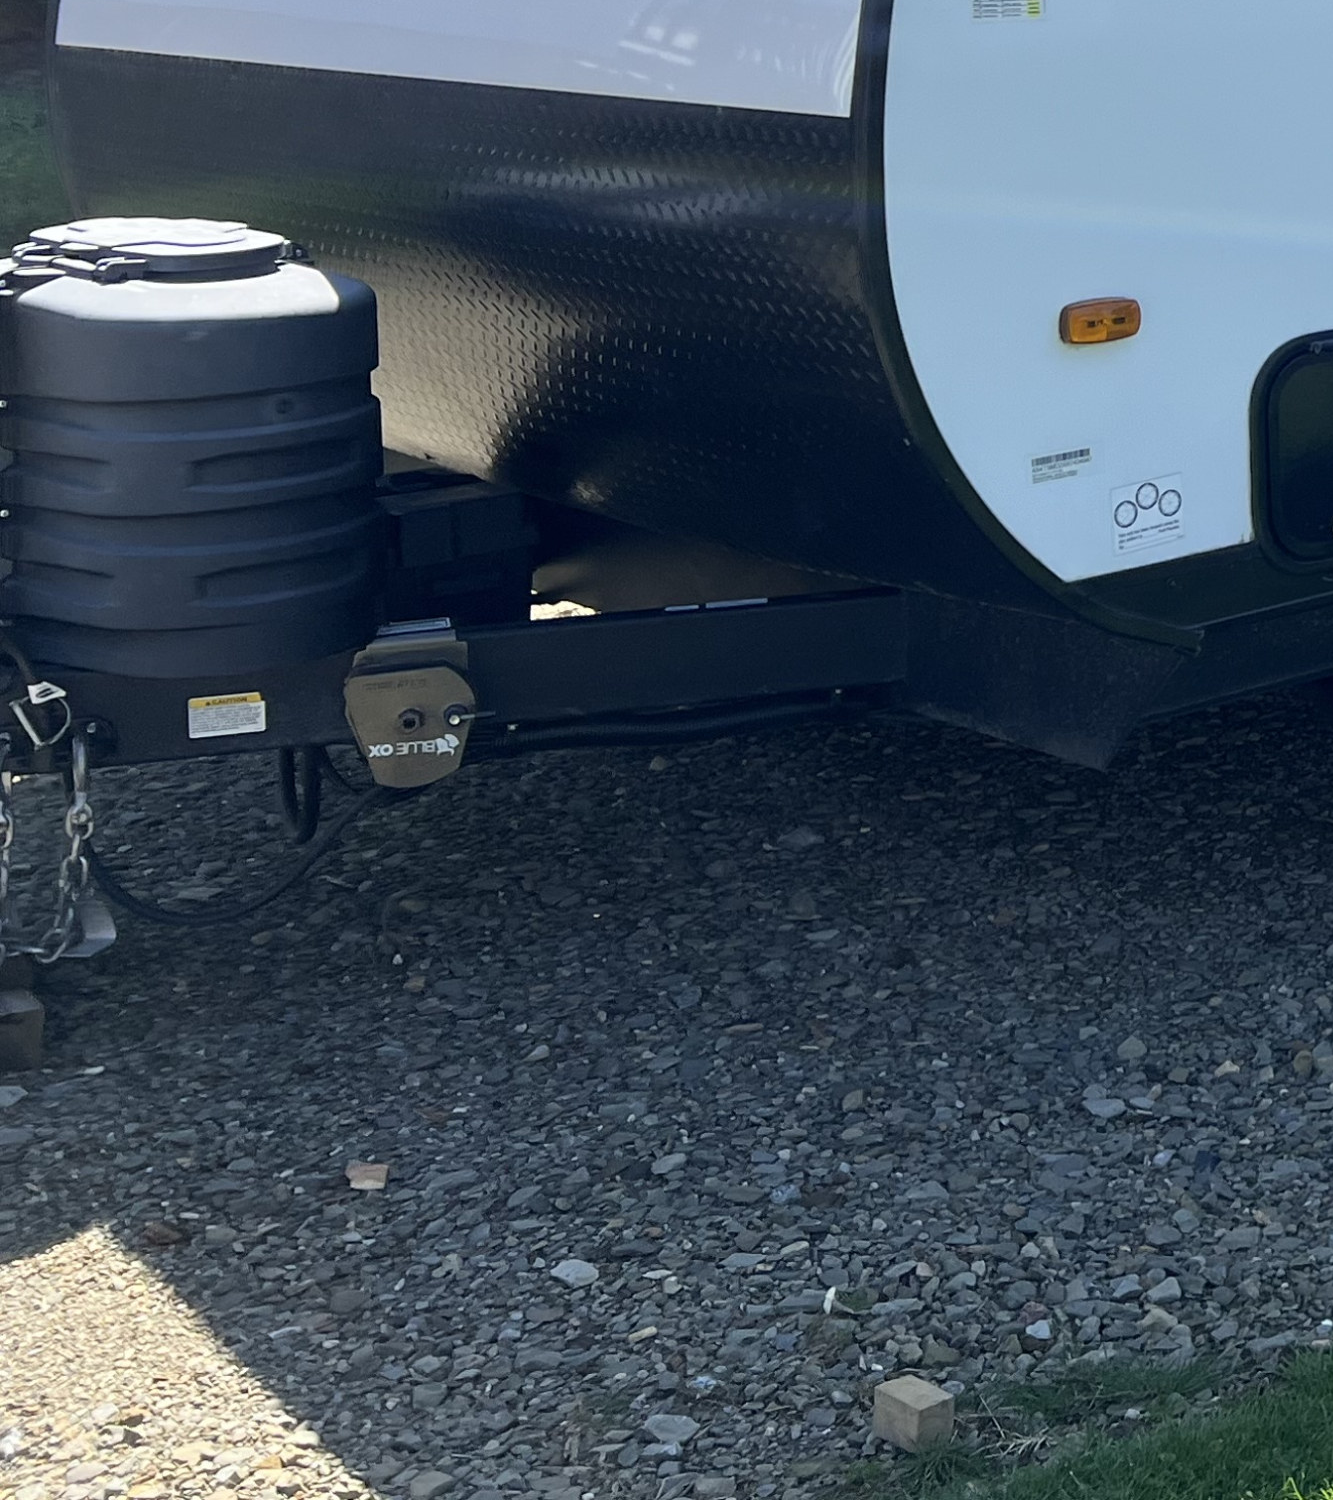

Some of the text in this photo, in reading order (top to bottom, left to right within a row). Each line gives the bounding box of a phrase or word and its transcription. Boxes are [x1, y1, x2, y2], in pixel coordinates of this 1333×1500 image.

[211, 696, 248, 705] CAUTION
[368, 740, 435, 758] BLUE OX
